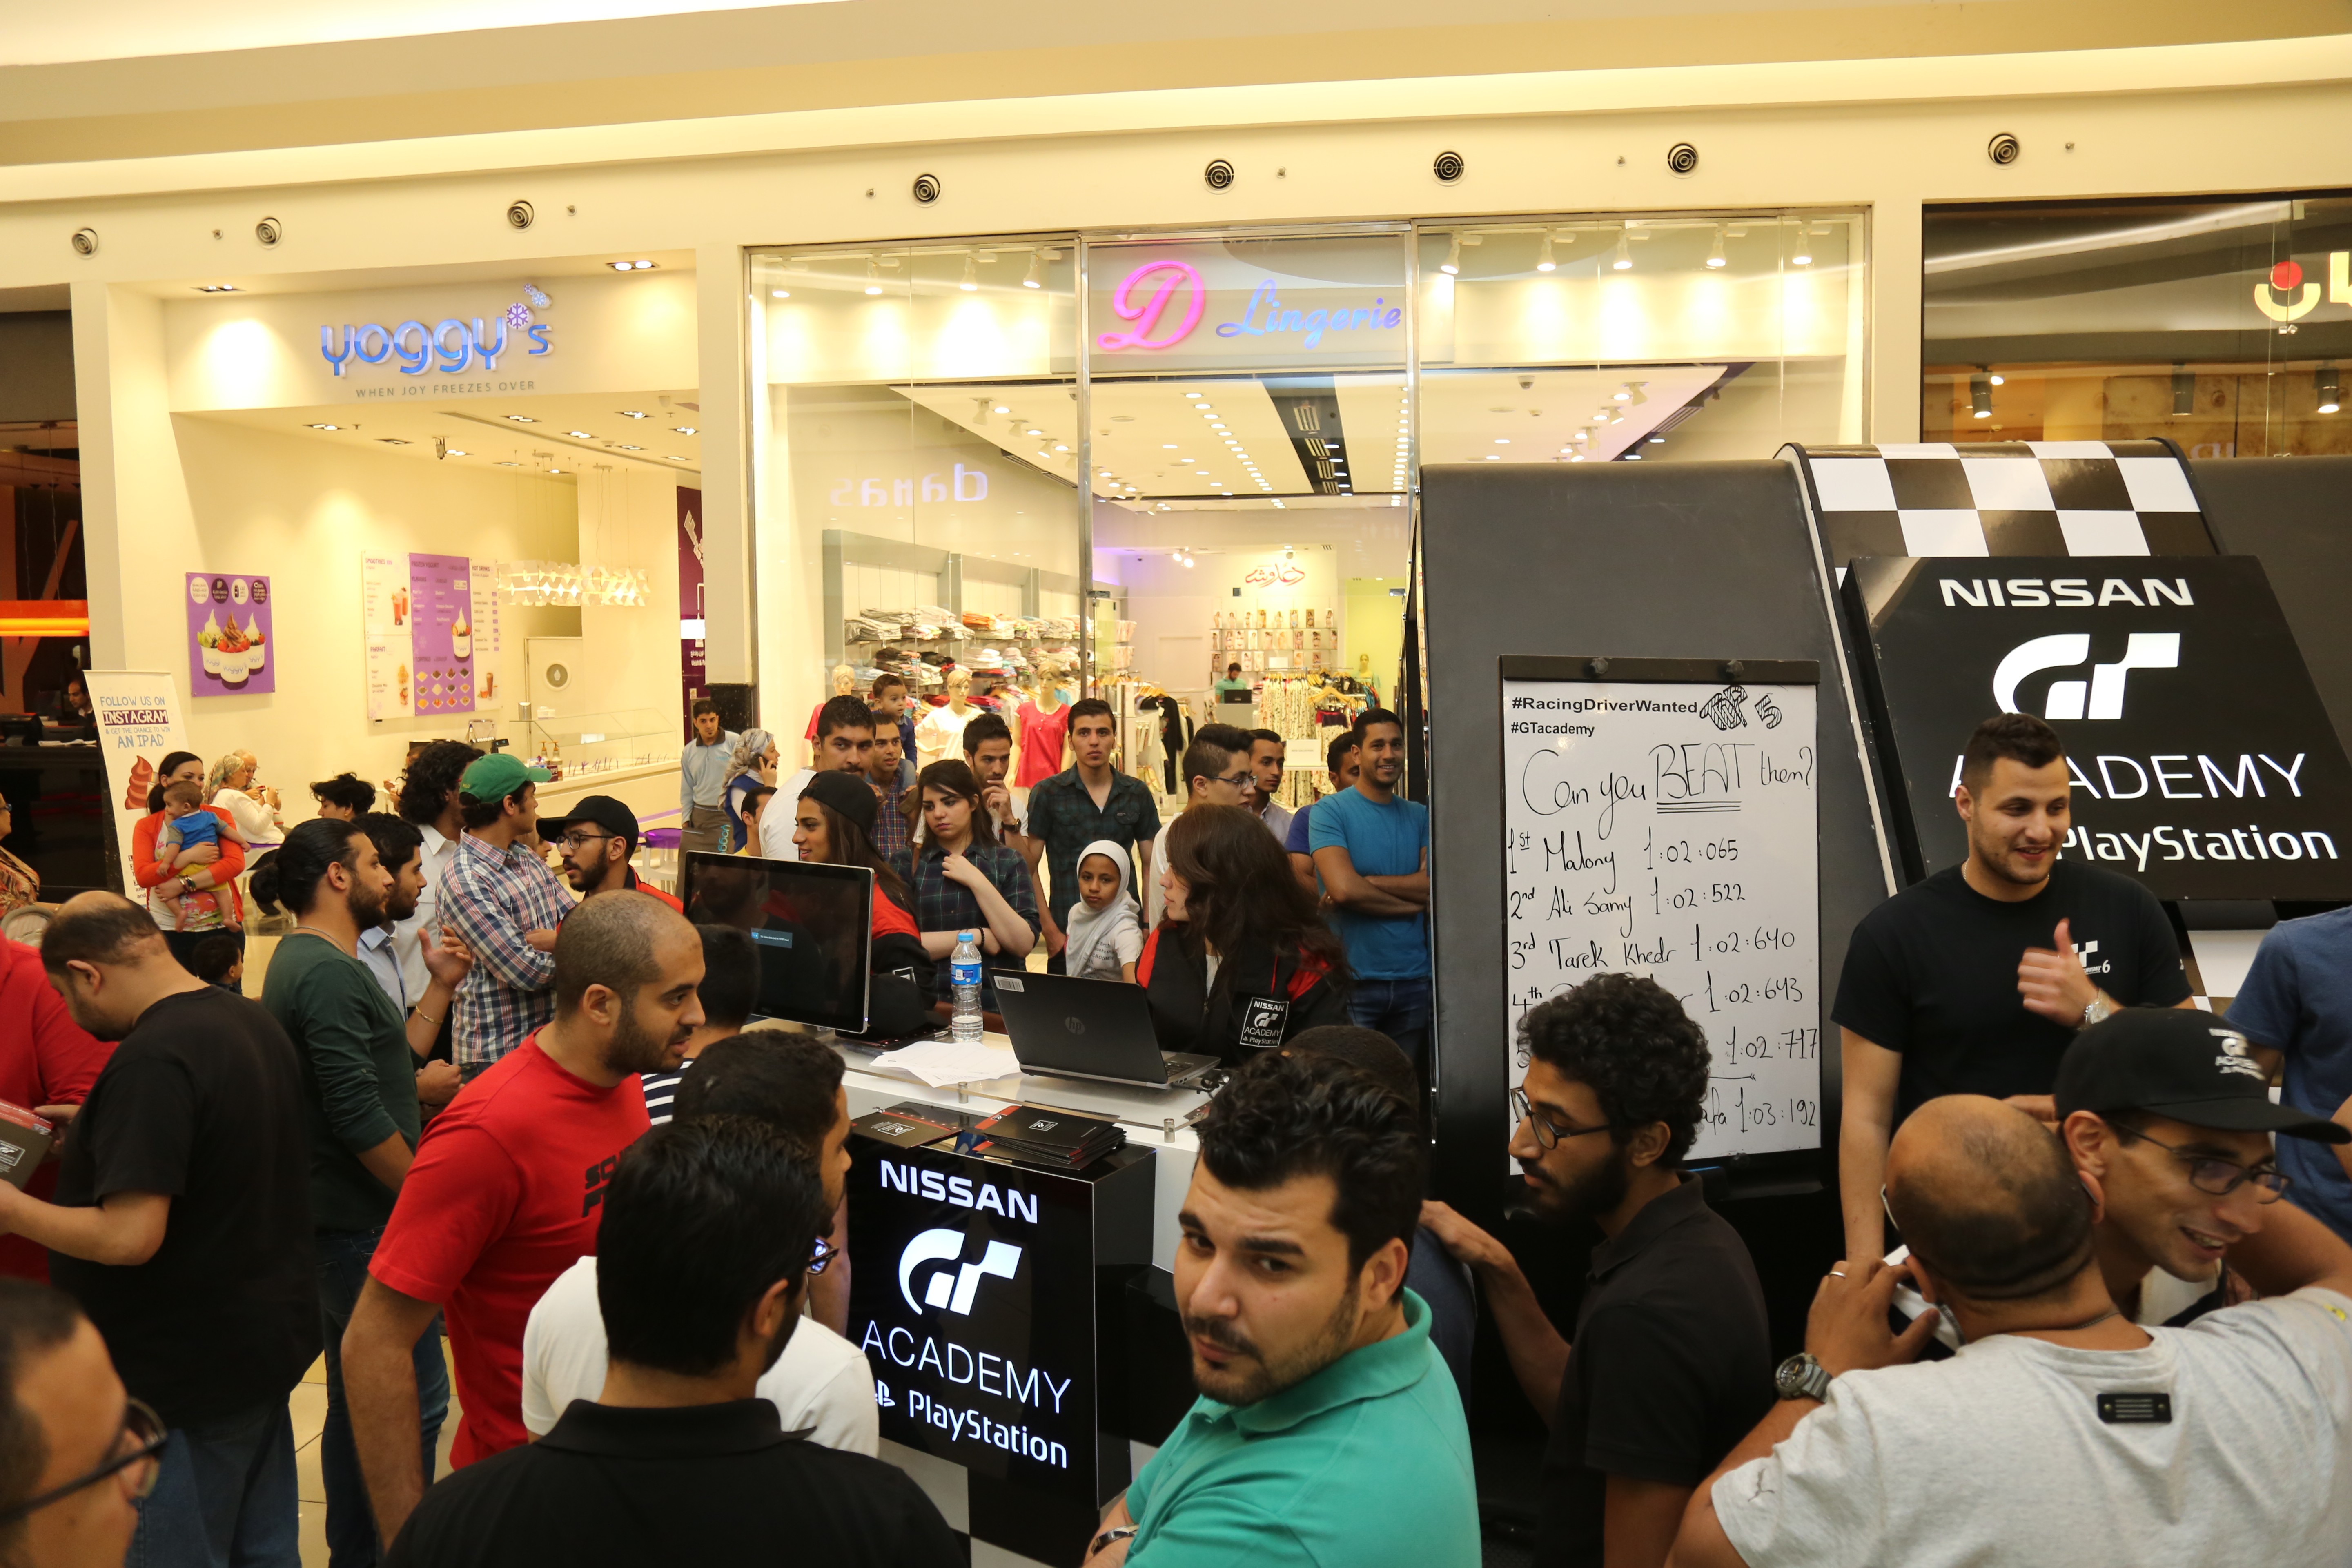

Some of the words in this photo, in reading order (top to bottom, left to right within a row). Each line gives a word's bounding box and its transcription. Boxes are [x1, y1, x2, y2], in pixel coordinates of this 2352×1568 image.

[1097, 260, 1205, 352] D
[1216, 279, 1401, 349] Lingerie
[321, 303, 553, 377] yoggy's
[356, 388, 394, 398] WHEN
[402, 385, 425, 396] JOY
[434, 383, 491, 394] FREEZES
[499, 381, 535, 392] OVER
[1939, 579, 2194, 607] NISSAN
[100, 696, 137, 707] FOLLOW
[140, 696, 151, 706] US
[155, 696, 165, 706] ON
[103, 710, 169, 724] INSTAGRAM
[1512, 697, 1698, 713] #RacingDriverWanted
[118, 735, 134, 748] AN
[138, 733, 164, 747] IPAD
[1511, 722, 1595, 737] #GTacademy
[1523, 749, 1588, 815] Can
[1598, 772, 1646, 840] you
[1648, 742, 1755, 799] BEAT
[1760, 746, 1813, 790] them?
[1949, 753, 2305, 799] ADEMY
[1508, 828, 1530, 873] 1st
[1644, 826, 1738, 870] 1:02:065
[1510, 888, 1535, 920] 2nd
[1546, 886, 1572, 920] Ali
[1584, 891, 1633, 939] Samy
[1651, 876, 1746, 915] 1:02:522
[1511, 932, 1535, 969] 3rd
[1549, 937, 1608, 970] Tarek
[1623, 936, 1677, 965] Khedr
[1690, 924, 1795, 962] 1:02:640
[2102, 959, 2111, 973] 6
[1253, 1000, 1285, 1011] NISSAN
[1512, 986, 1542, 1018] 4th
[1705, 971, 1803, 1012] 1:02:643
[1068, 1017, 1082, 1034] hp
[1244, 1026, 1281, 1037] ACADEMY
[1250, 1036, 1278, 1045] PlayStation
[1735, 1087, 1815, 1133] 1:03:192
[881, 1160, 1038, 1224] NISSAN
[862, 1320, 1071, 1414] ACADEMY
[909, 1389, 1067, 1469] PlayStation
